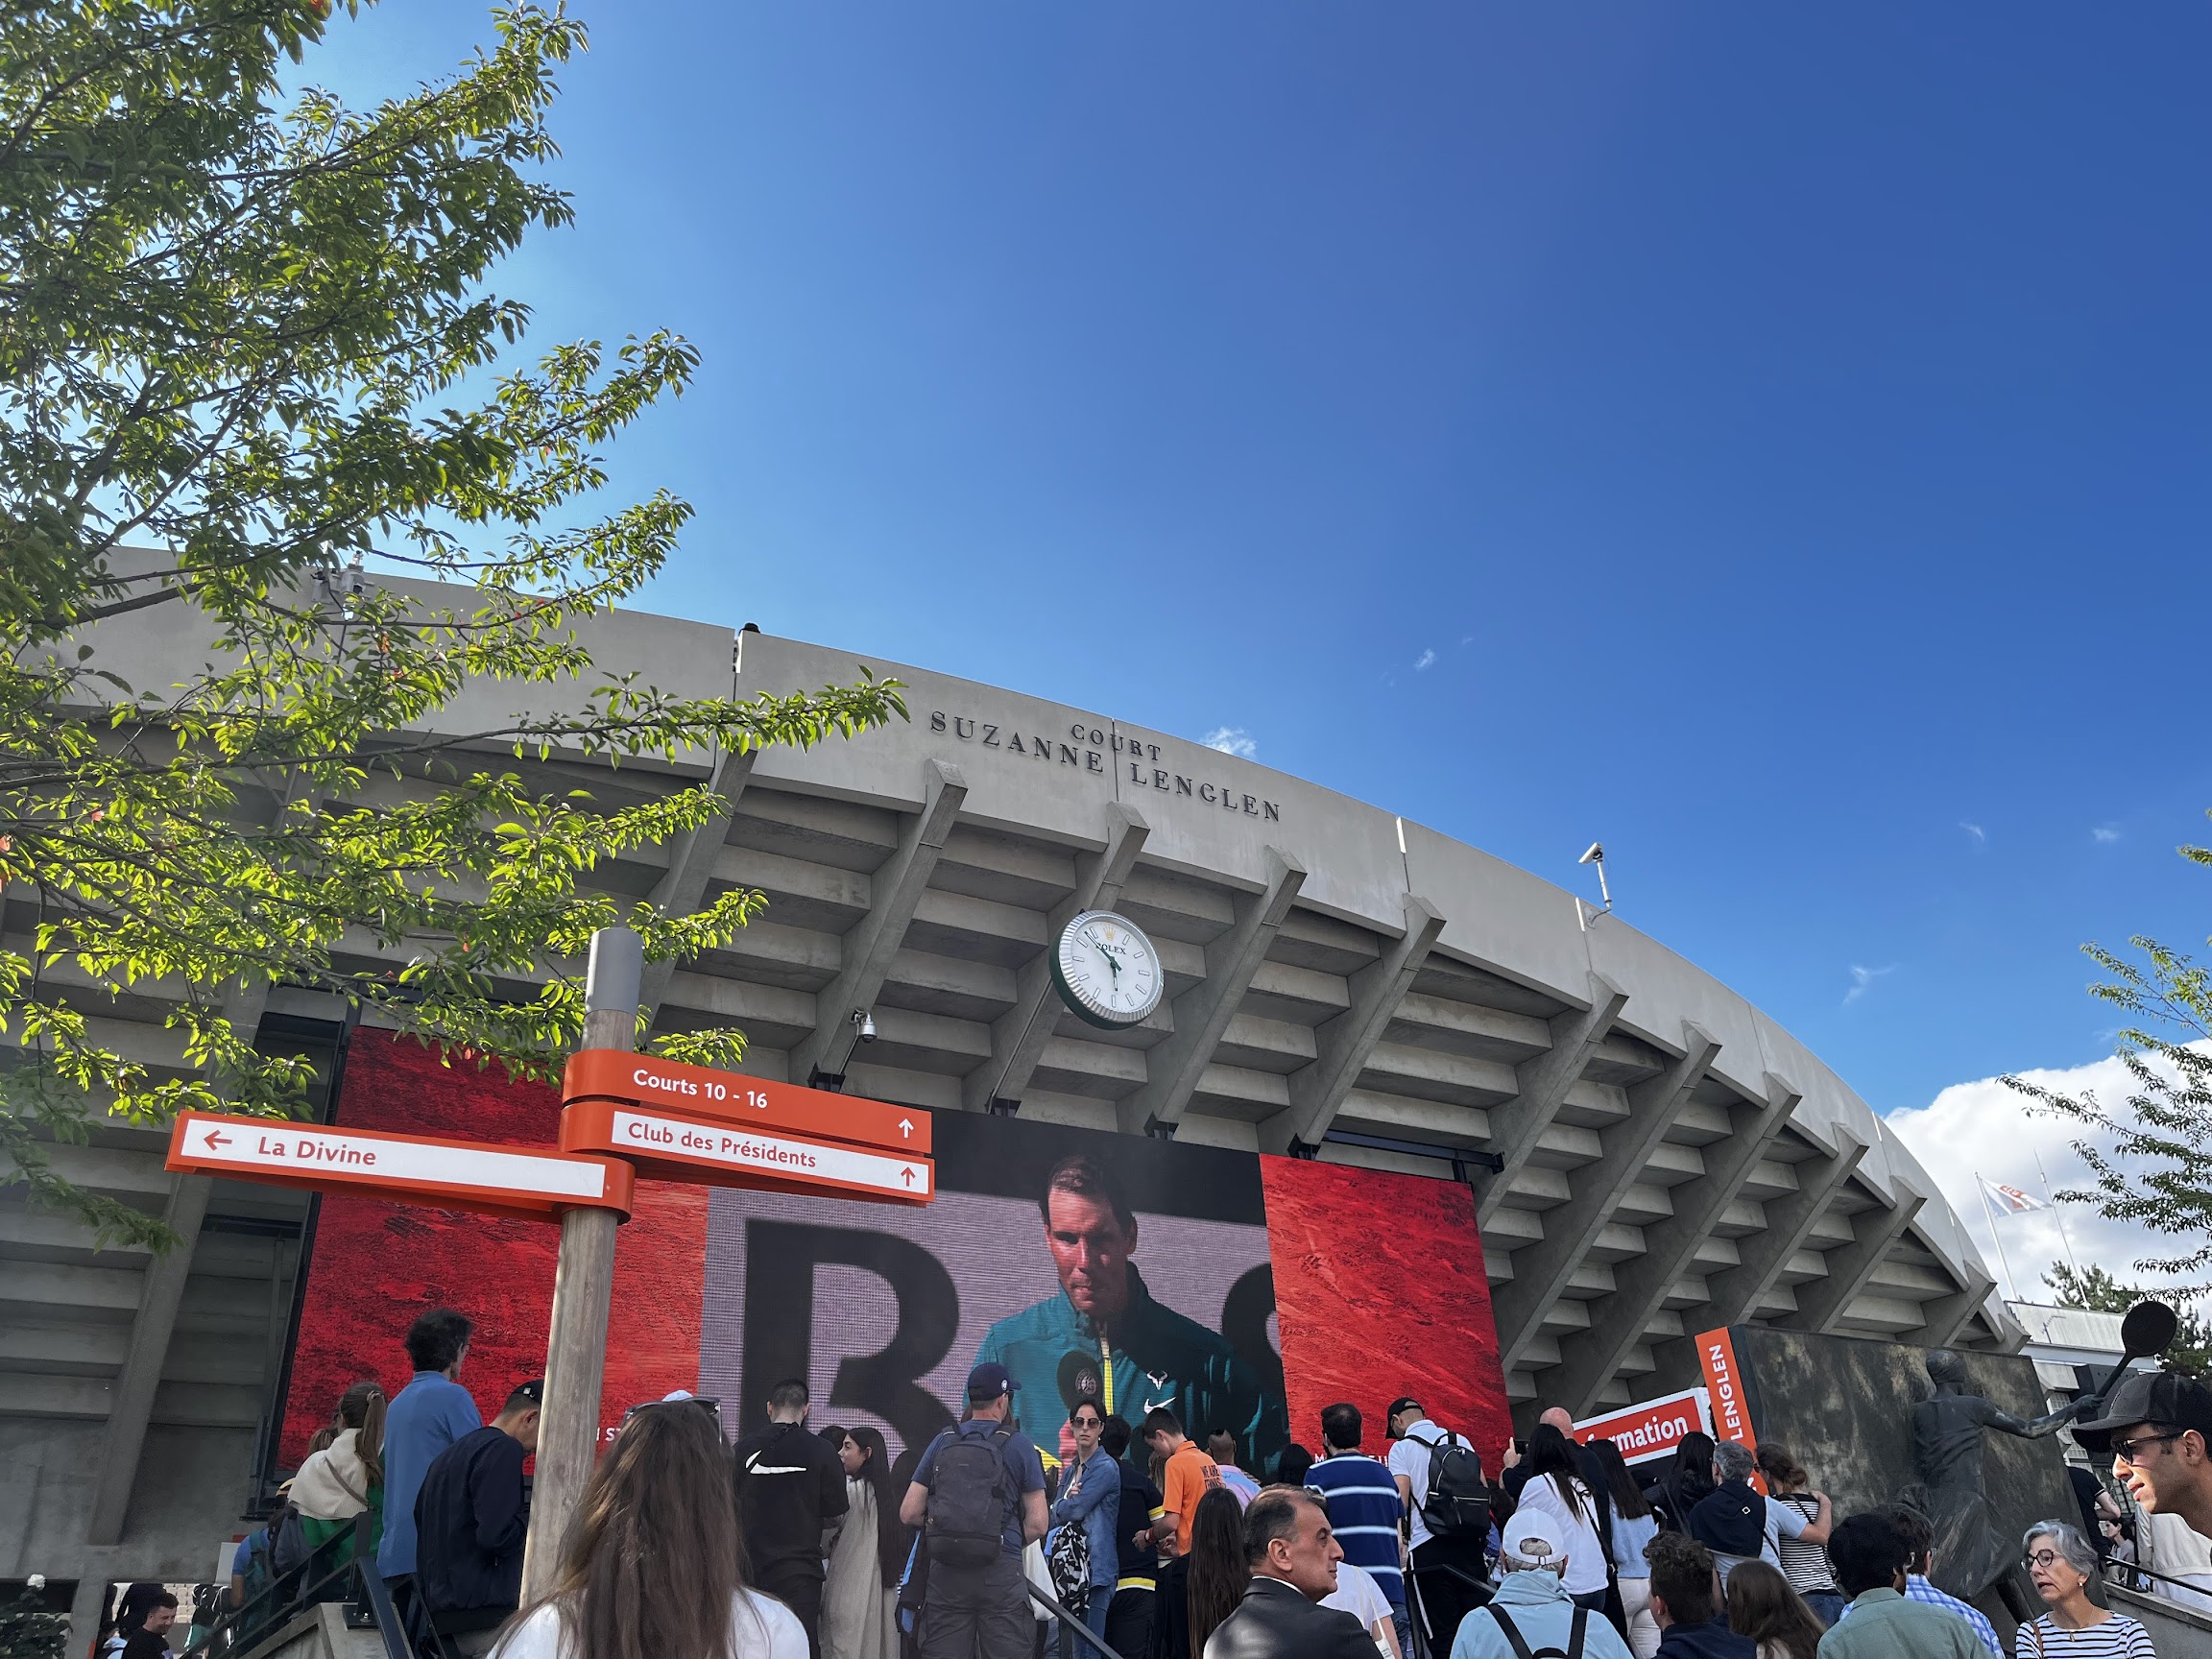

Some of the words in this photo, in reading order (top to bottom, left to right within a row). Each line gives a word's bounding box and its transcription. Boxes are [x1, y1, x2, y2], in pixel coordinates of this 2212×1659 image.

[1070, 724, 1161, 761] COURT
[930, 710, 1104, 773] SUZANNE
[1130, 762, 1280, 822] LENGLEN
[633, 1069, 698, 1095] Courts
[704, 1082, 727, 1101] 10
[747, 1090, 768, 1109] 16
[257, 1136, 286, 1157] La
[296, 1140, 376, 1166] Divine
[628, 1122, 674, 1143] Club
[681, 1131, 713, 1151] des
[721, 1138, 816, 1167] Présidents
[1708, 1344, 1743, 1441] LENGLEN
